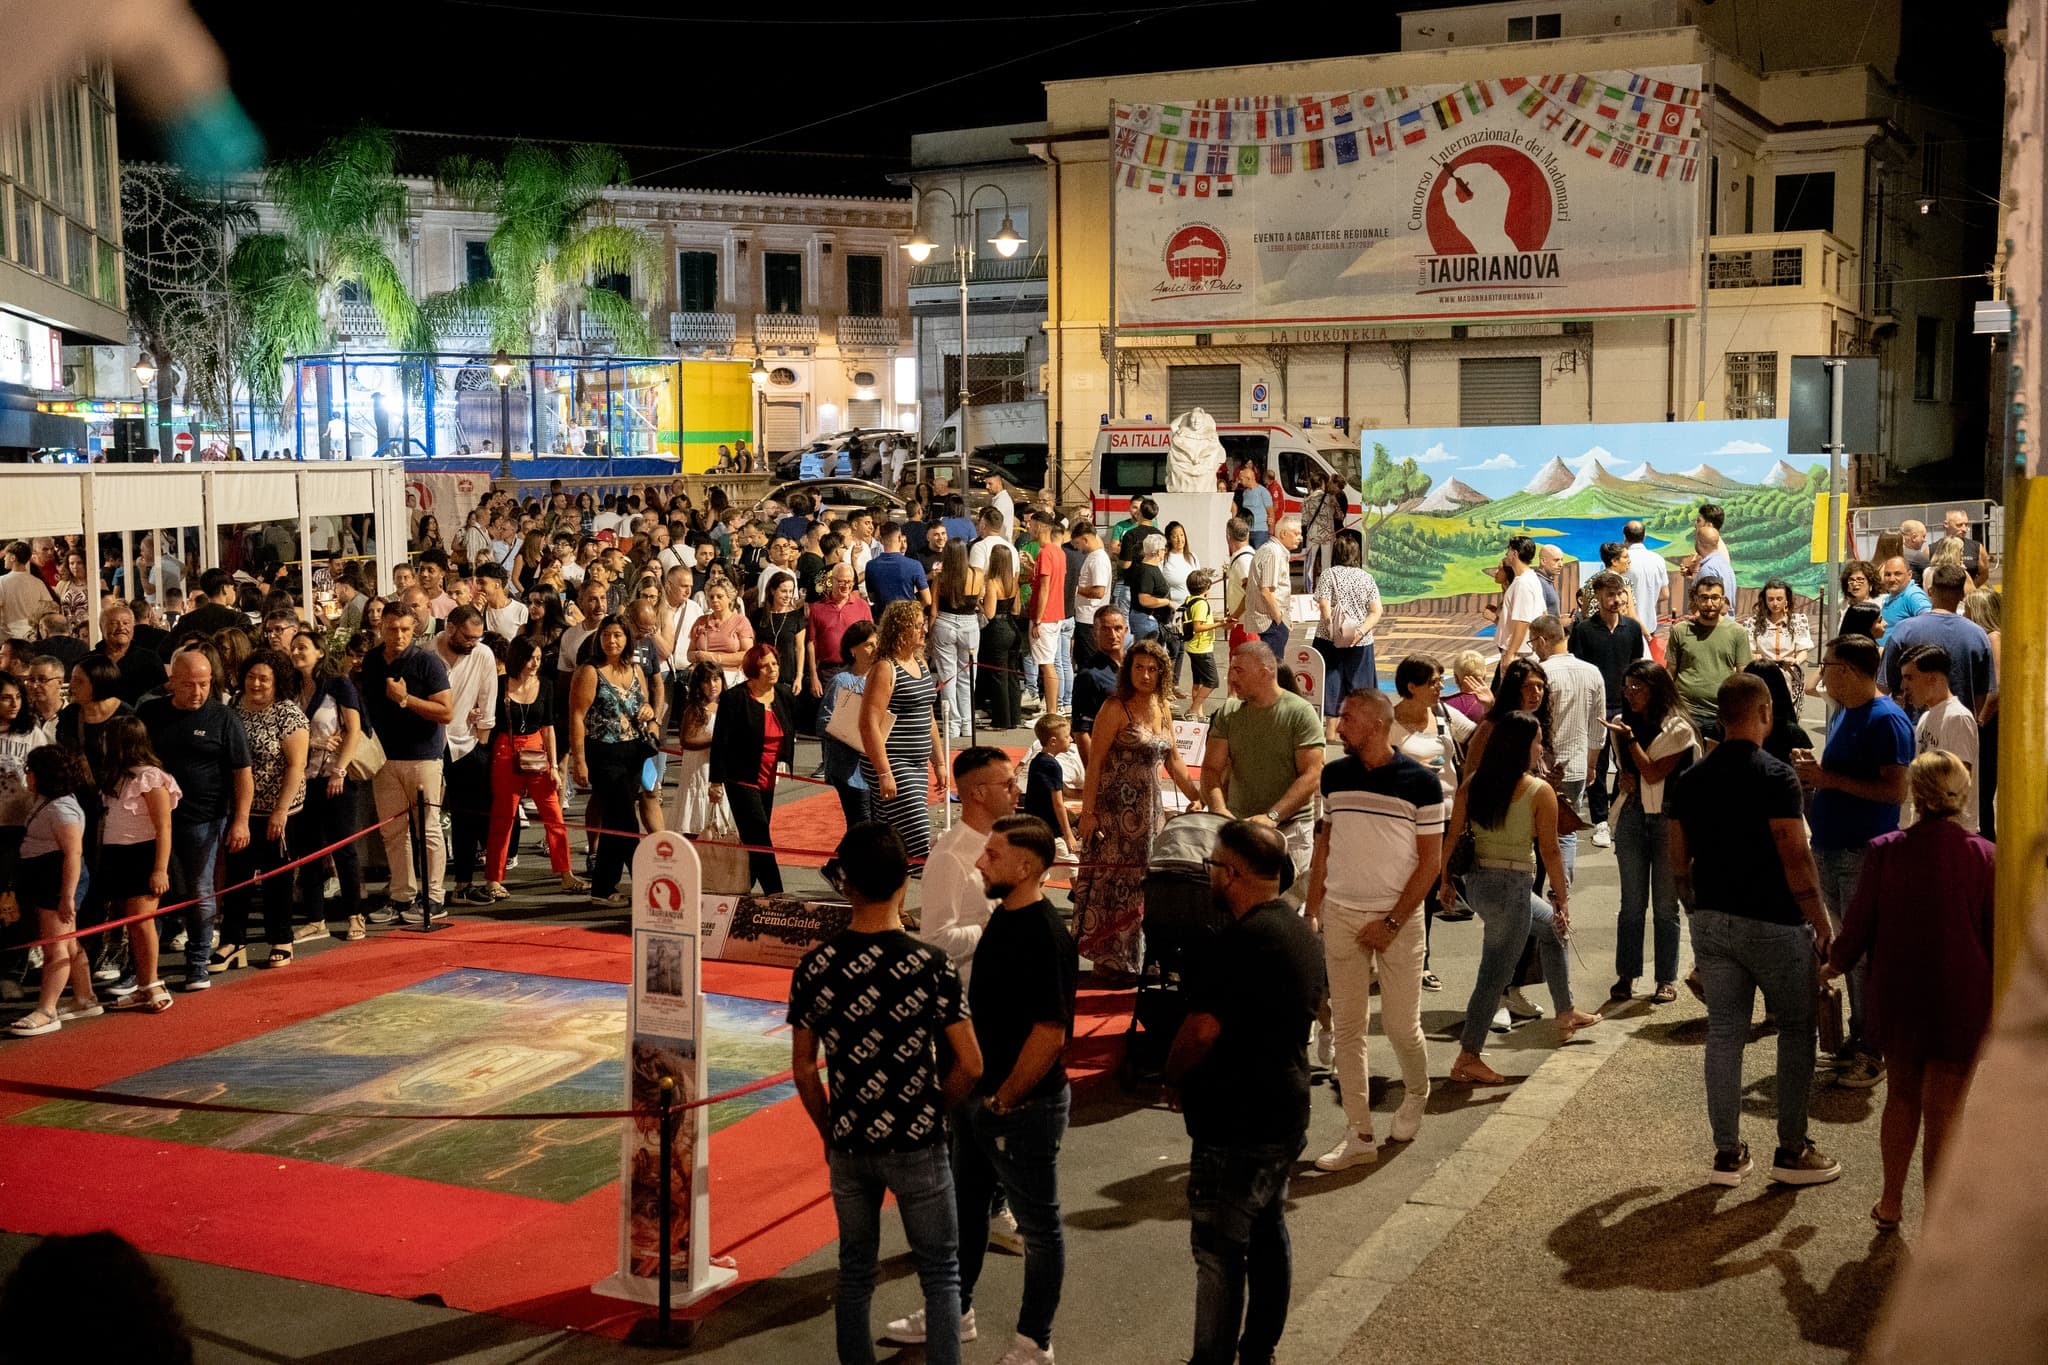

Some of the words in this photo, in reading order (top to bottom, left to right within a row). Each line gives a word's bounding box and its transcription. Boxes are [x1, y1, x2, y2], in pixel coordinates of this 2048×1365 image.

[1408, 171, 1433, 231] Concorso
[1428, 128, 1524, 167] Internazionale
[1525, 138, 1546, 157] dei
[1540, 152, 1571, 222] Madonnari
[1254, 233, 1284, 243] EVENTO
[1287, 232, 1292, 241] A
[1295, 230, 1340, 241] CARATTERE
[1344, 228, 1389, 240] REGIONALE
[1428, 253, 1560, 283] TAURIANOVA
[1152, 280, 1187, 293] Amici
[1210, 279, 1242, 291] Palco
[1271, 329, 1288, 342] LA
[1132, 434, 1172, 447] ITALIA
[752, 914, 821, 929] CremaCialde
[842, 944, 884, 980] ICON
[889, 948, 932, 980] ICON
[843, 985, 881, 1022] ICON
[889, 986, 929, 1022] ICON
[848, 1028, 884, 1064] ICON
[893, 1026, 927, 1063] ICON
[856, 1069, 888, 1104] ICON
[898, 1065, 928, 1103] ICON
[864, 1110, 896, 1144] ICON
[906, 1104, 936, 1140] ICON
